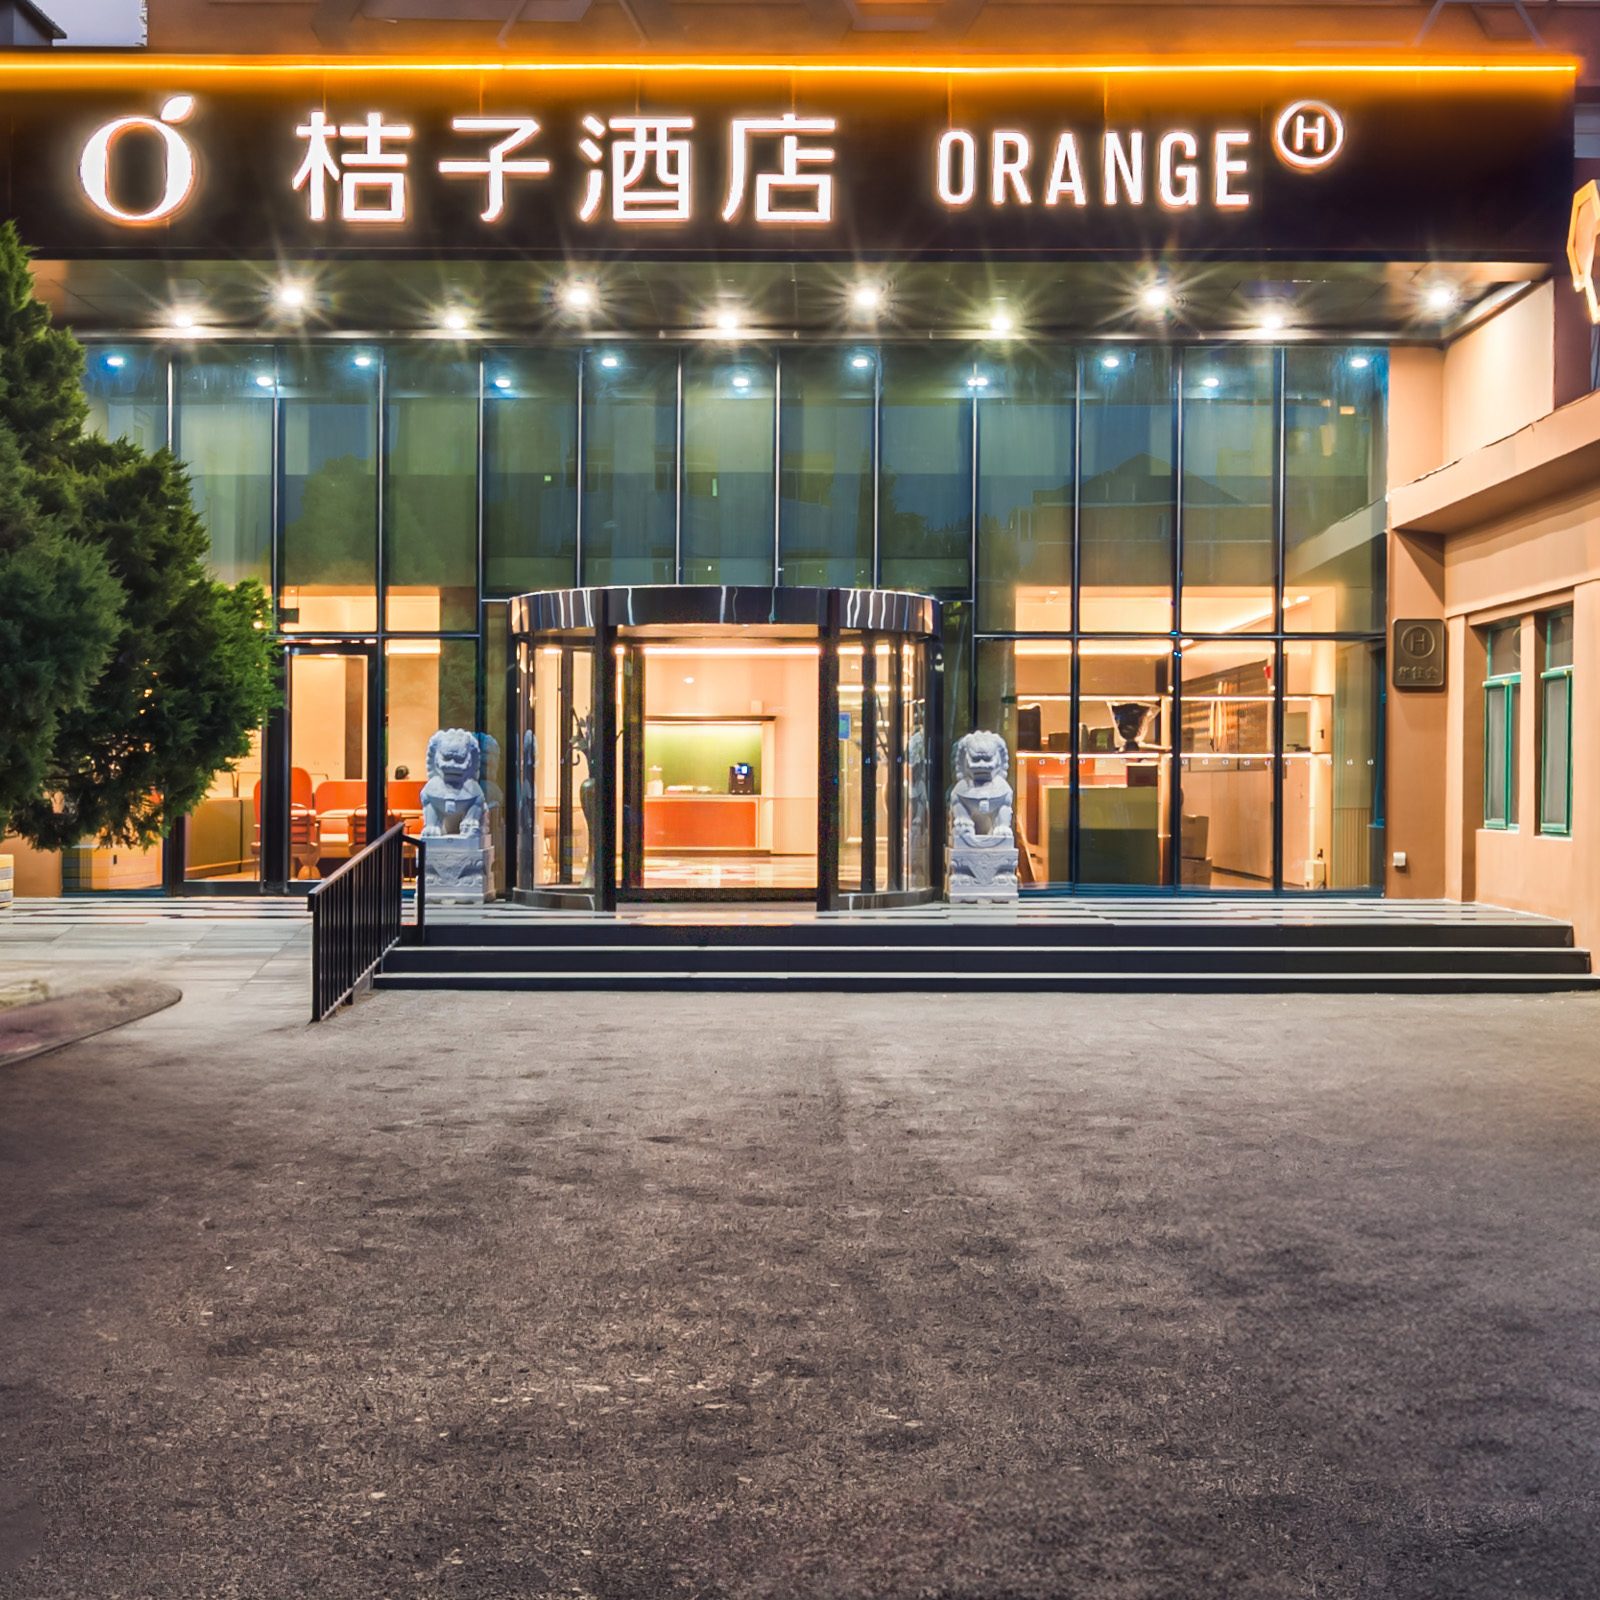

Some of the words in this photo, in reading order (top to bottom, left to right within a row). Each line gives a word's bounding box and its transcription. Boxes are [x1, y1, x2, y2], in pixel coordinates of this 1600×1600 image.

[292, 111, 836, 222] 桔子酒店
[937, 129, 1250, 206] ORANGE
